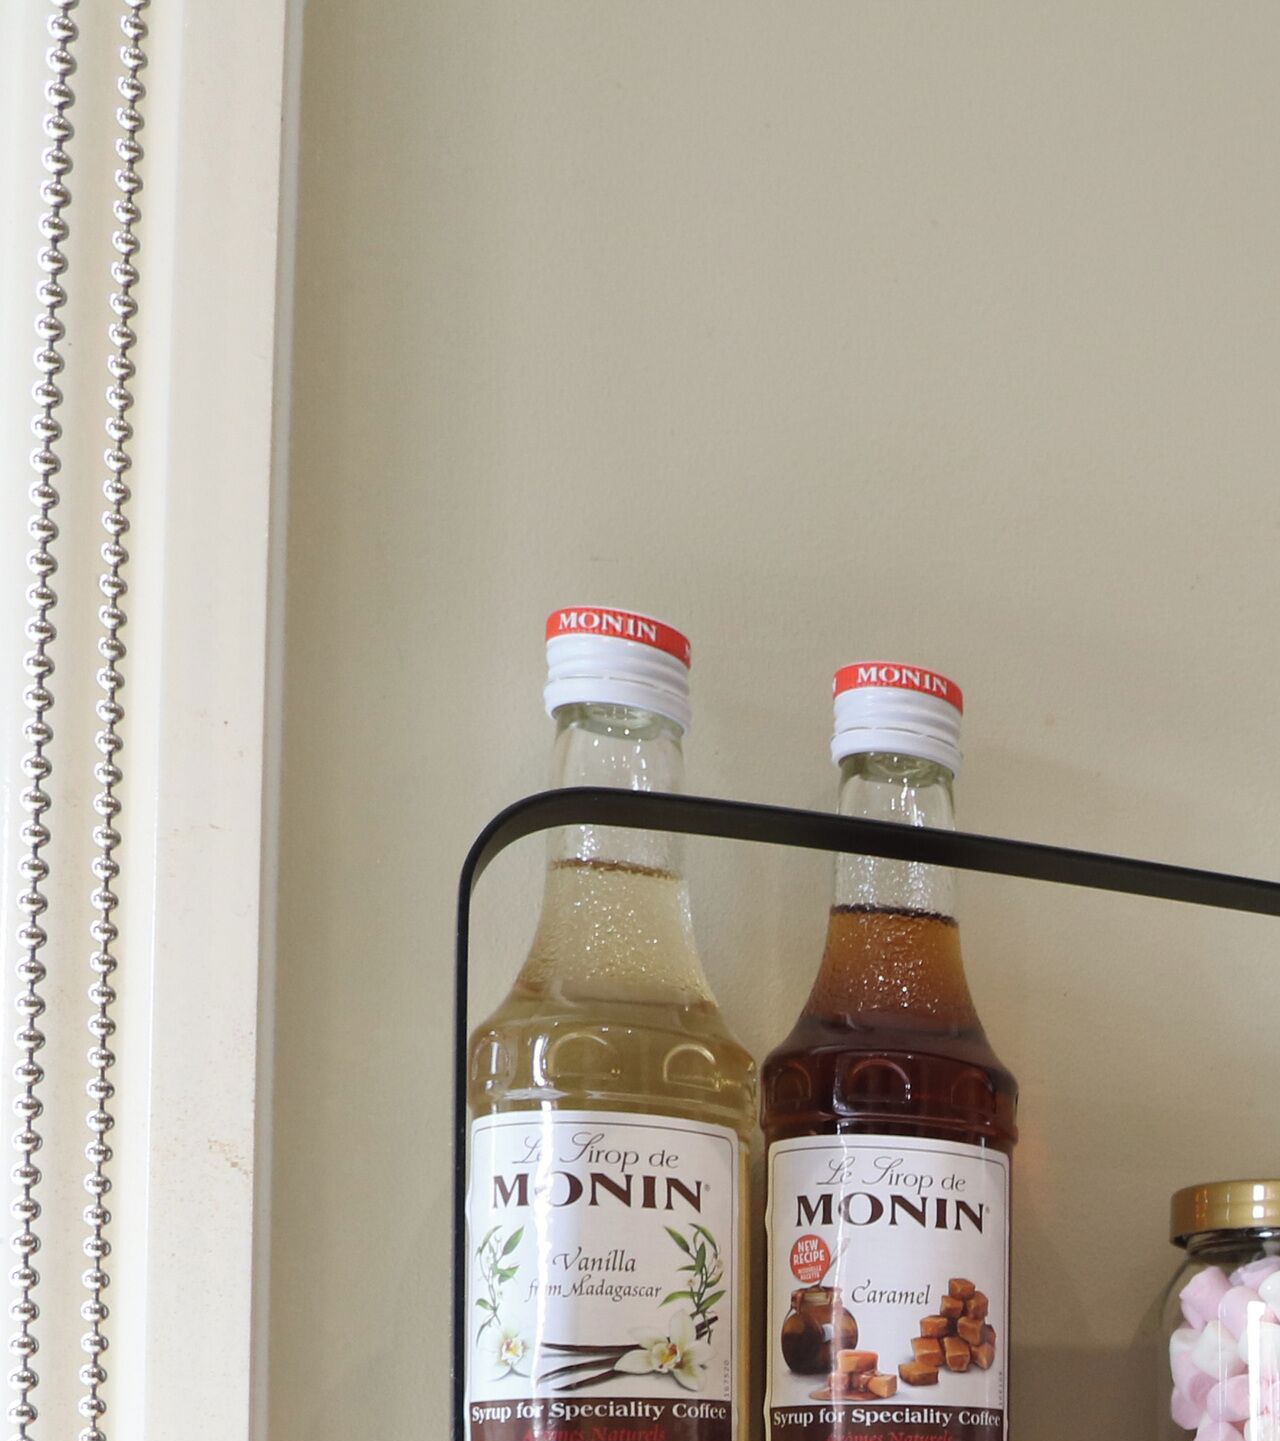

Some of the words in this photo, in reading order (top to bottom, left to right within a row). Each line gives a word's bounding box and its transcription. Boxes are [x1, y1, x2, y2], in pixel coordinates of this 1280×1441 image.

[557, 611, 657, 642] MONIN
[857, 666, 949, 695] MONIN
[560, 1131, 639, 1172] Sirop
[649, 1150, 679, 1169] de
[816, 1156, 855, 1185] Le
[862, 1156, 933, 1194] Sirop
[941, 1174, 966, 1192] de
[493, 1171, 702, 1213] MONIN
[796, 1192, 984, 1234] MONIN
[552, 1246, 636, 1272] Vanilla
[793, 1249, 825, 1265] RECIPE
[797, 1238, 818, 1253] NEW
[524, 1279, 562, 1302] frm
[562, 1274, 662, 1302] Madagascar
[851, 1280, 930, 1304] Caramel
[472, 1405, 511, 1424] Syrup
[517, 1401, 544, 1419] for
[549, 1401, 665, 1421] Speciality
[672, 1403, 726, 1420] Coffee
[774, 1411, 814, 1426] Syrup
[819, 1408, 845, 1423] for
[851, 1408, 952, 1427] Speciality
[958, 1411, 1000, 1427] Coffee
